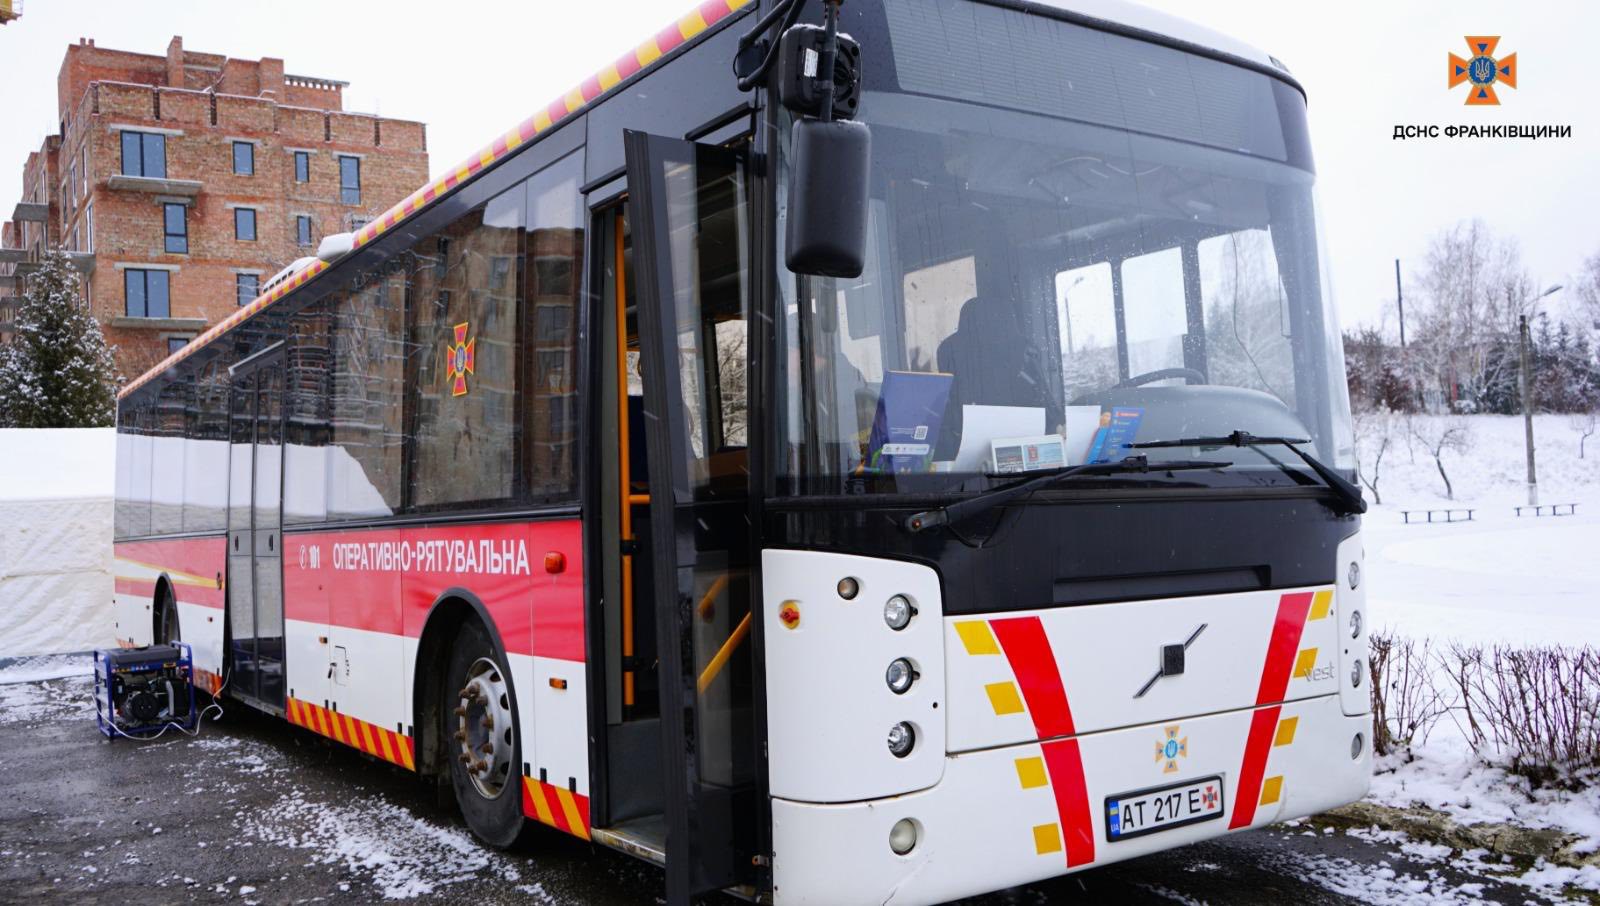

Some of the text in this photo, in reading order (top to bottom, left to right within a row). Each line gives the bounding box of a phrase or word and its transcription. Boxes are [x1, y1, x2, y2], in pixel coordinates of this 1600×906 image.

[309, 539, 530, 576] 101 ОПЕРАТИВНО-РЯТУВАЛЬНА
[1110, 822, 1120, 833] UA
[1122, 788, 1201, 830] AT 217 E
